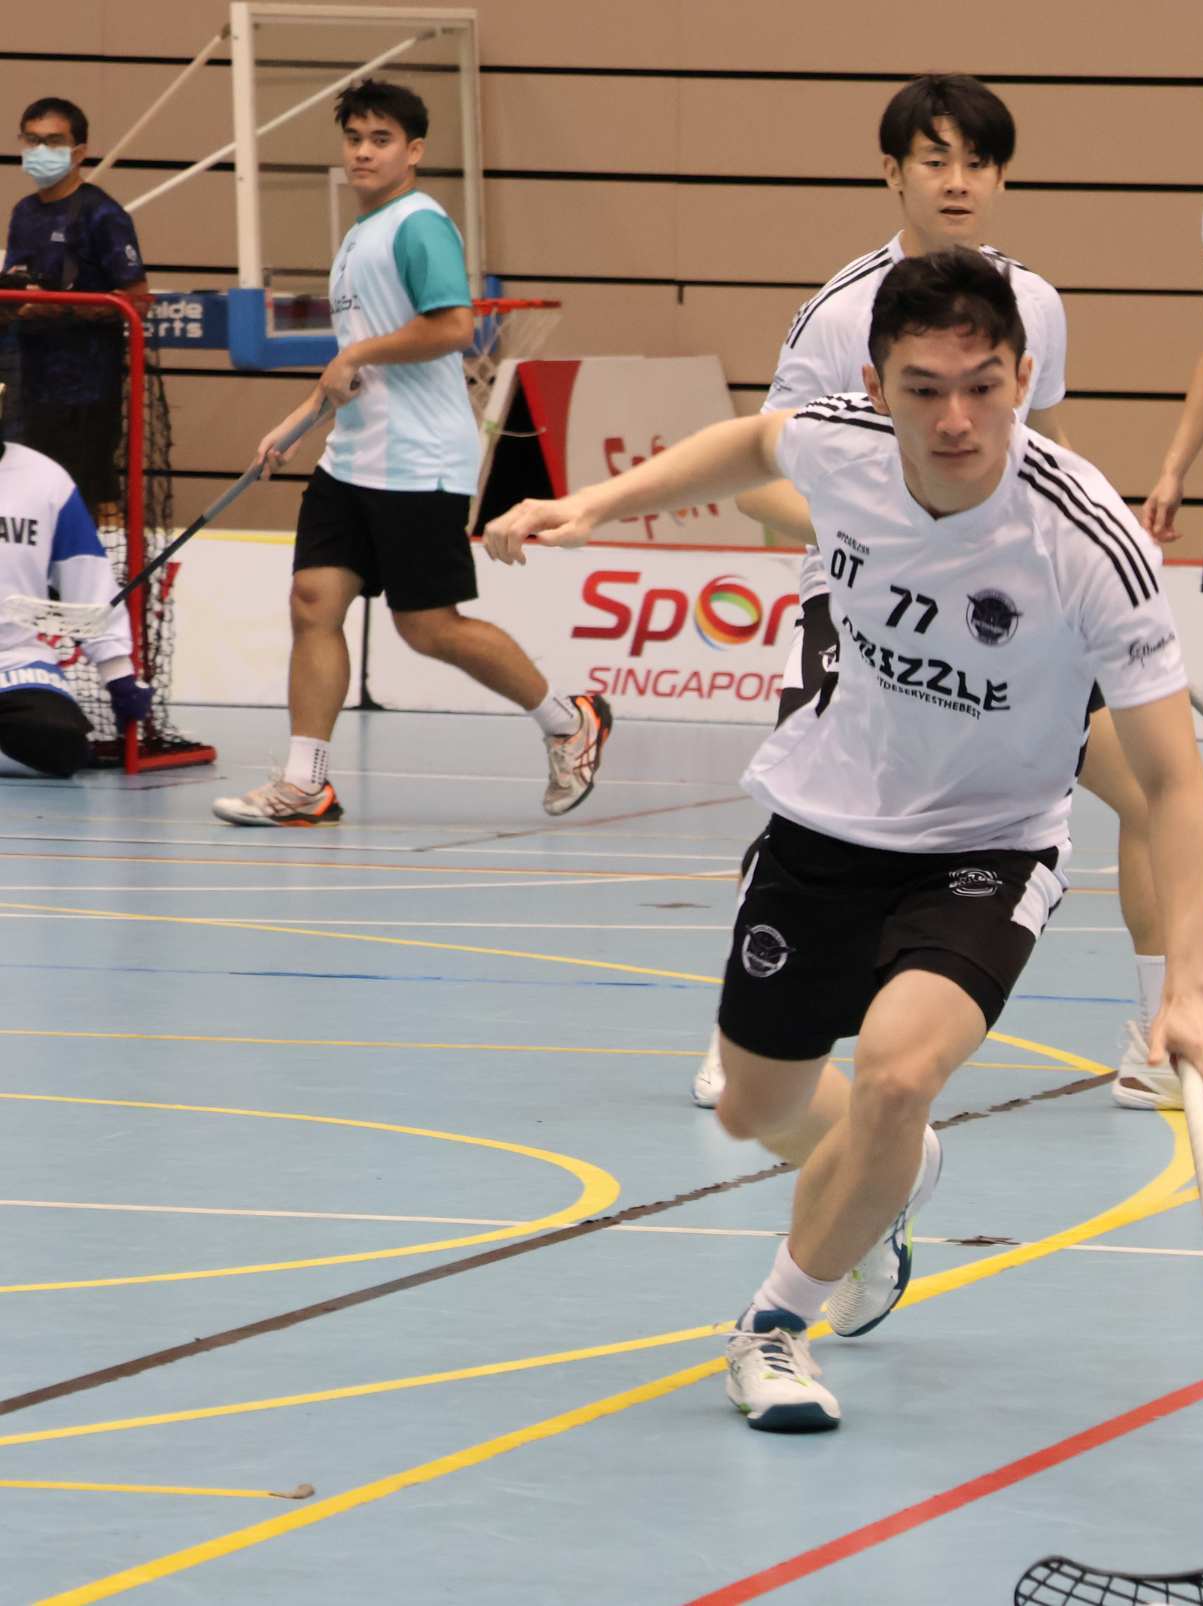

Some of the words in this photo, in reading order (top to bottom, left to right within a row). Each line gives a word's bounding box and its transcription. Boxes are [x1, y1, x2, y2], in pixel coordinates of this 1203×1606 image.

[571, 570, 800, 657] Spor
[886, 584, 938, 634] 77
[585, 667, 784, 702] SINGAPOR
